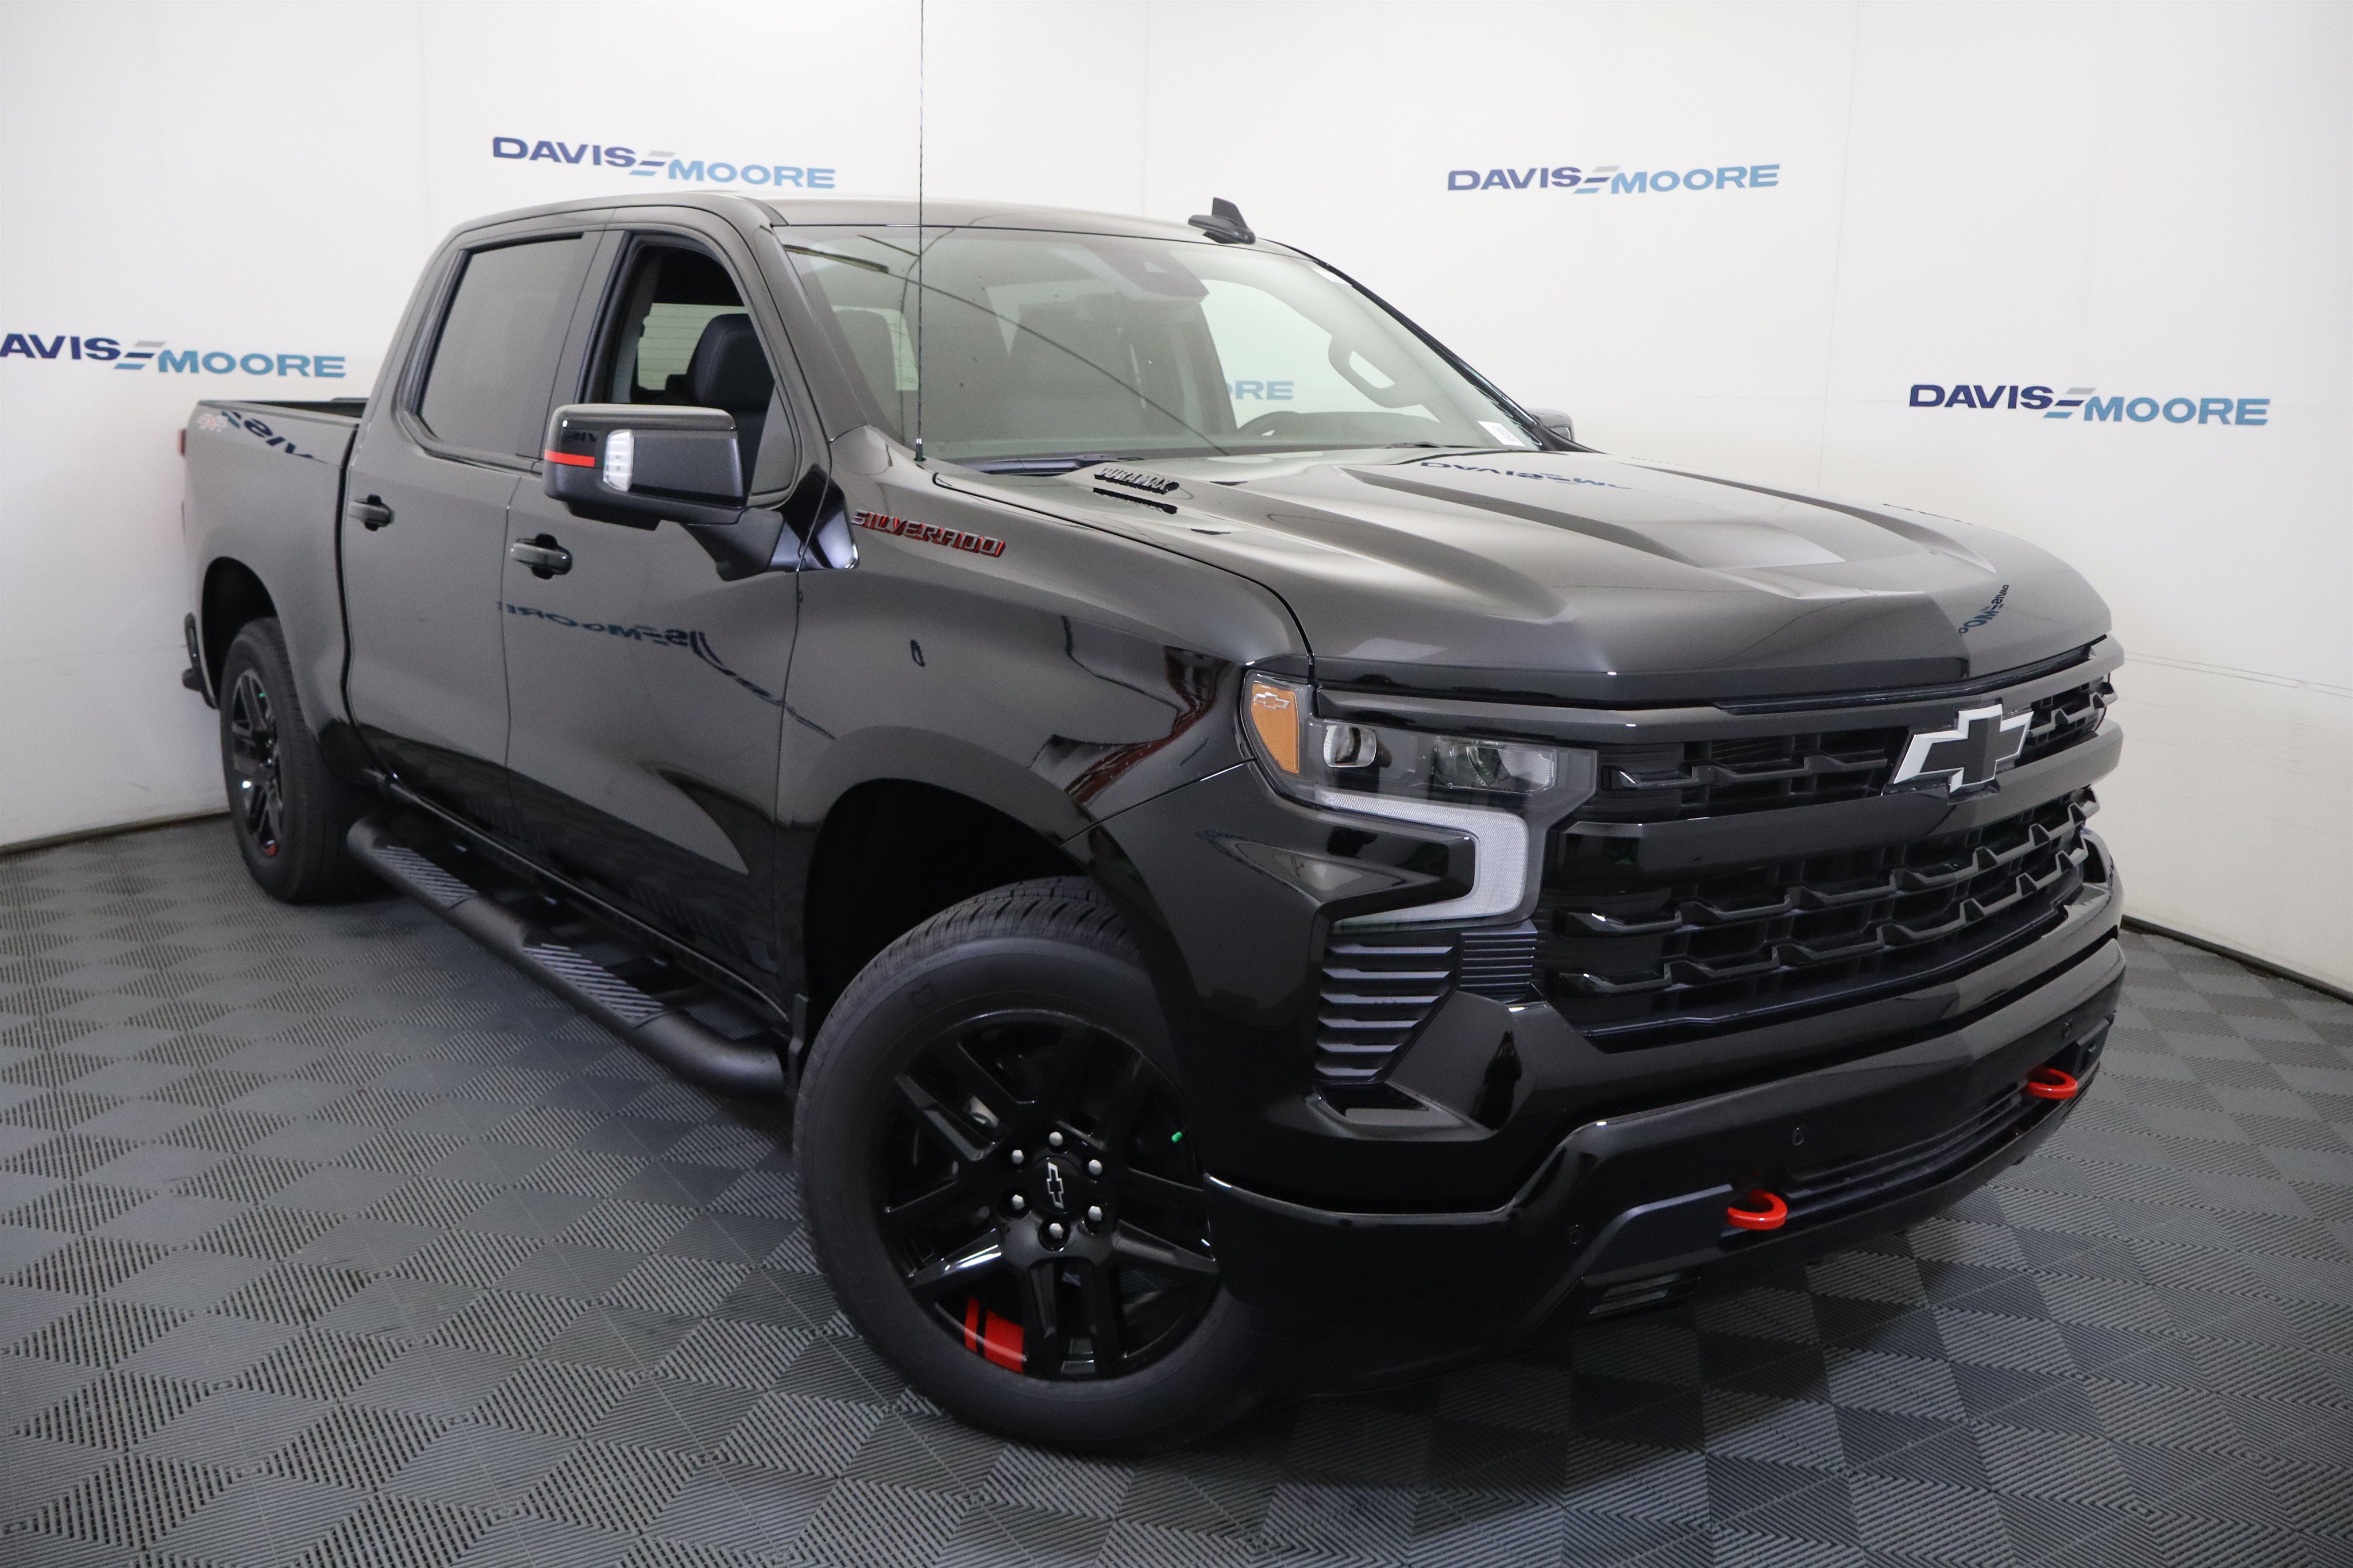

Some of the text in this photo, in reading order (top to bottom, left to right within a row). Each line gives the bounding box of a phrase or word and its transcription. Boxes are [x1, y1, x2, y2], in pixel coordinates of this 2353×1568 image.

[493, 137, 836, 189] DAVIS MOORE
[1448, 164, 1780, 195] DAVIS MOORE
[158, 349, 346, 378] MOORE
[1909, 384, 2271, 426] DAVIS MOORE
[851, 509, 1005, 557] SILVERADO
